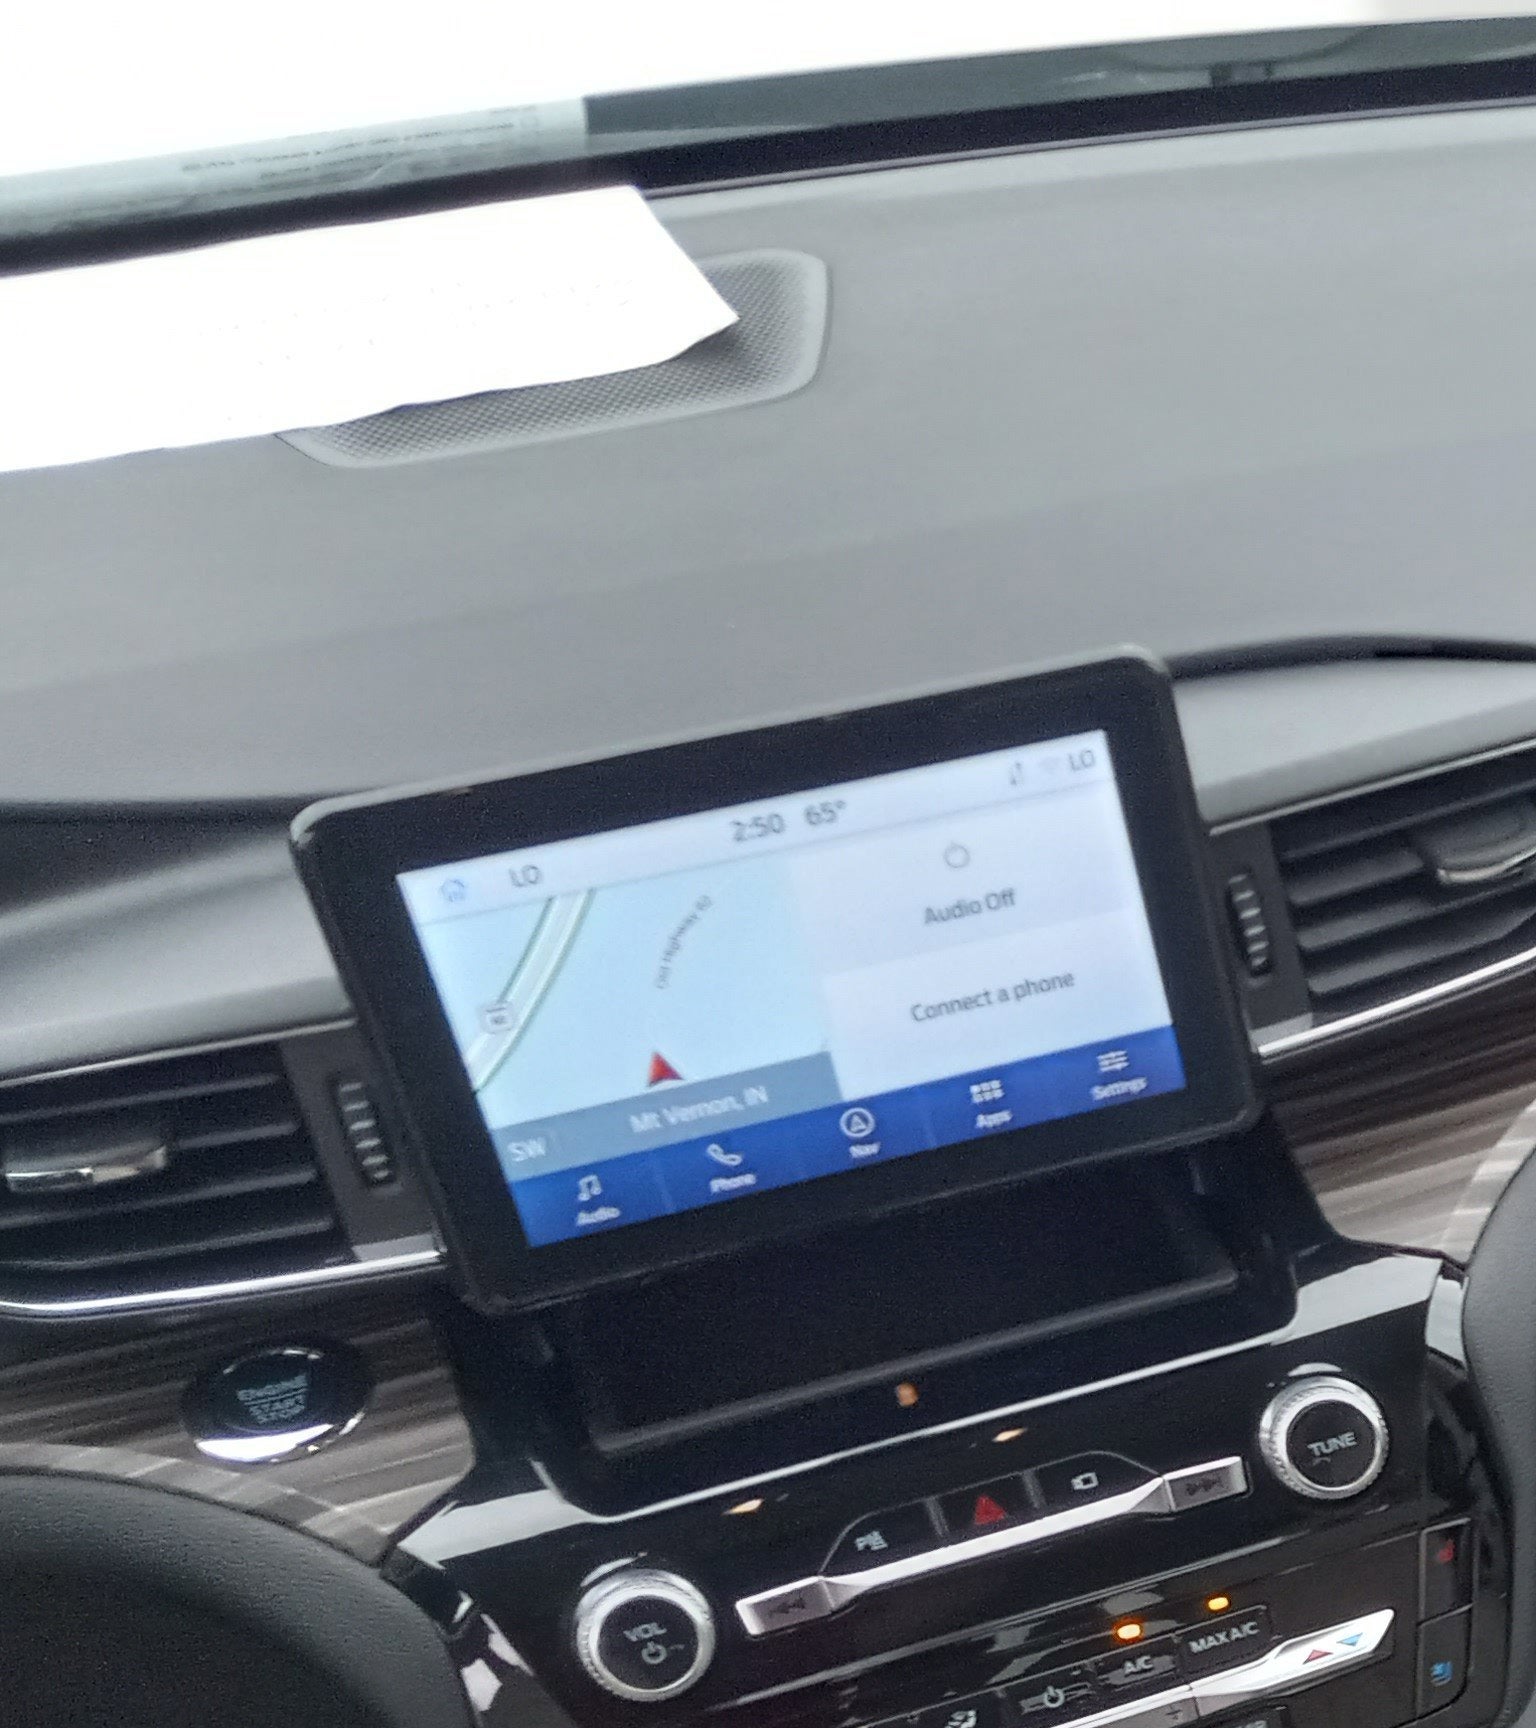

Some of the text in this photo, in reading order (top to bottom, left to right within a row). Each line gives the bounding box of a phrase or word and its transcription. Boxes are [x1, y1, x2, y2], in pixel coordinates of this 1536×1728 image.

[732, 812, 785, 842] 2:50
[924, 888, 1016, 924] Audio Off
[910, 972, 1076, 1022] Connect a phone
[1090, 1077, 1148, 1101] Settings
[976, 1110, 1013, 1129] Apps
[507, 1137, 547, 1162] SW
[709, 1173, 756, 1193] Phone
[576, 1207, 621, 1226] Audio
[1307, 1431, 1360, 1457] TUNE
[623, 1622, 668, 1642] VOL
[1188, 1621, 1261, 1653] MAX A/C
[1123, 1655, 1154, 1674] A/C
